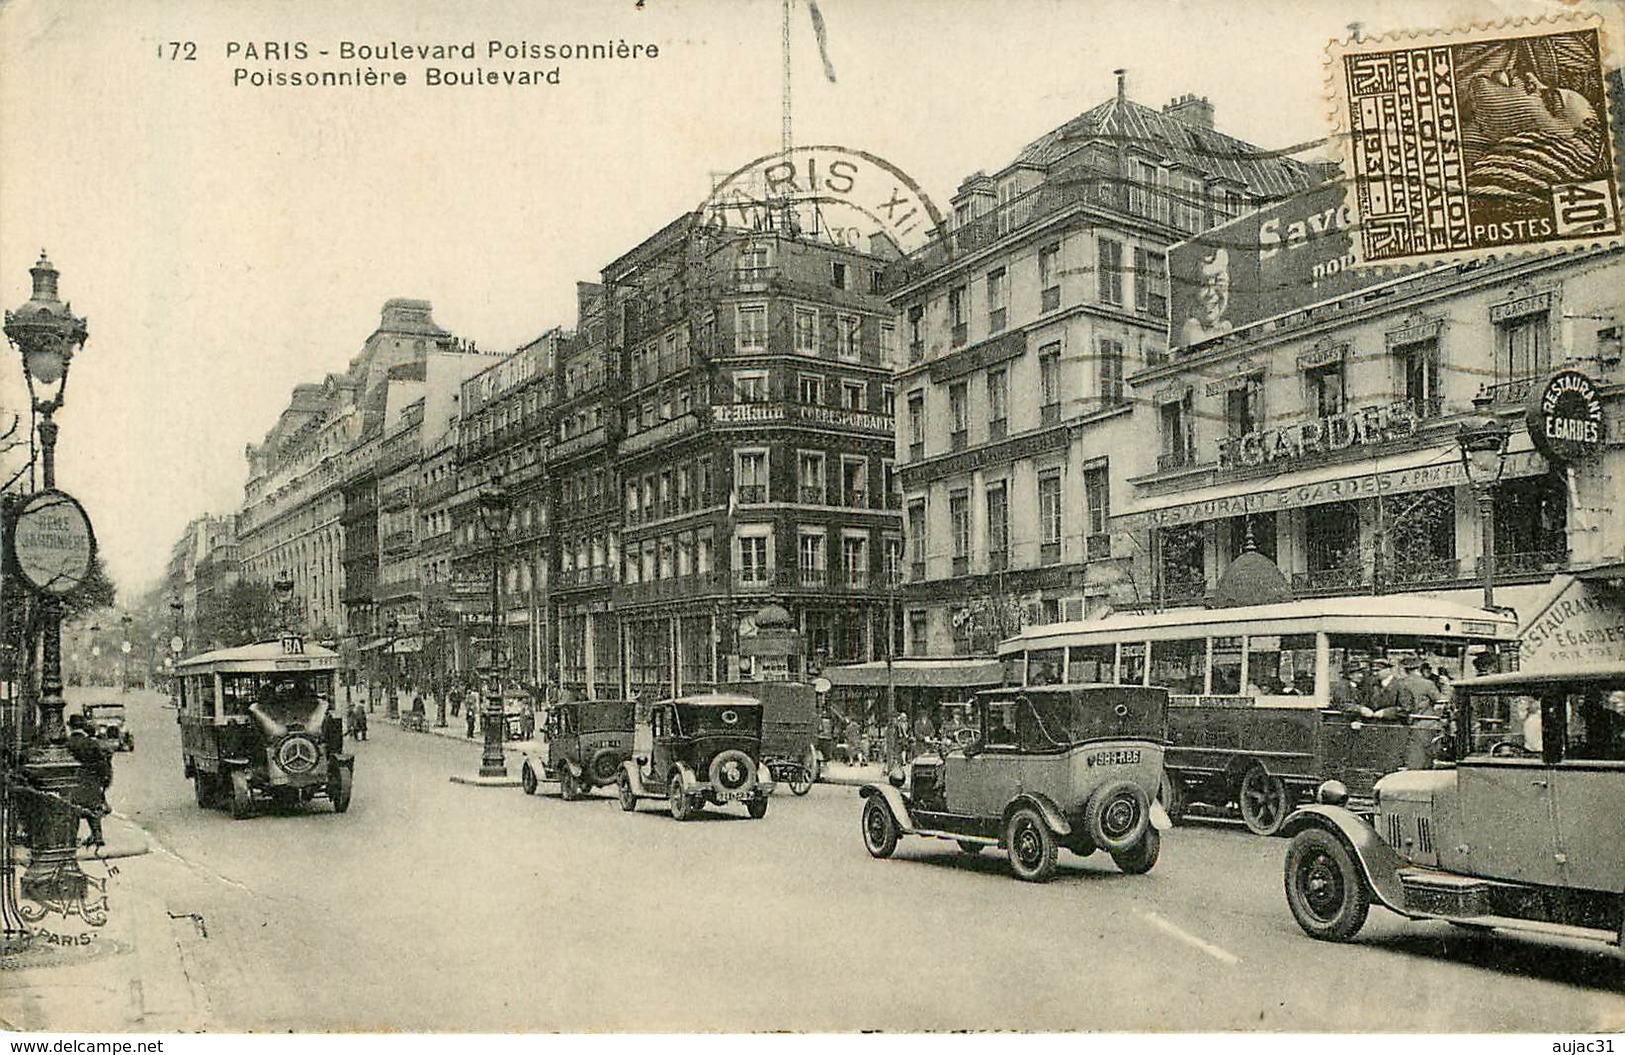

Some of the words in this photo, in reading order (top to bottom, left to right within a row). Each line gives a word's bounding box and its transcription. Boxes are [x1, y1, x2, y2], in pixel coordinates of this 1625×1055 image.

[1383, 95, 1395, 125] DE
[1394, 52, 1426, 253] INTERNATIONALE
[1411, 51, 1447, 251] COLONIALE
[1433, 48, 1471, 249] EXPOSITION
[1387, 144, 1406, 214] PARIS
[1473, 218, 1552, 242] POSTES
[1543, 375, 1602, 421] RESTAURANT
[1239, 396, 1419, 466] GARDES
[1150, 492, 1269, 524] RESTAURANT
[1299, 474, 1392, 501] GARDES
[284, 639, 302, 654] BA
